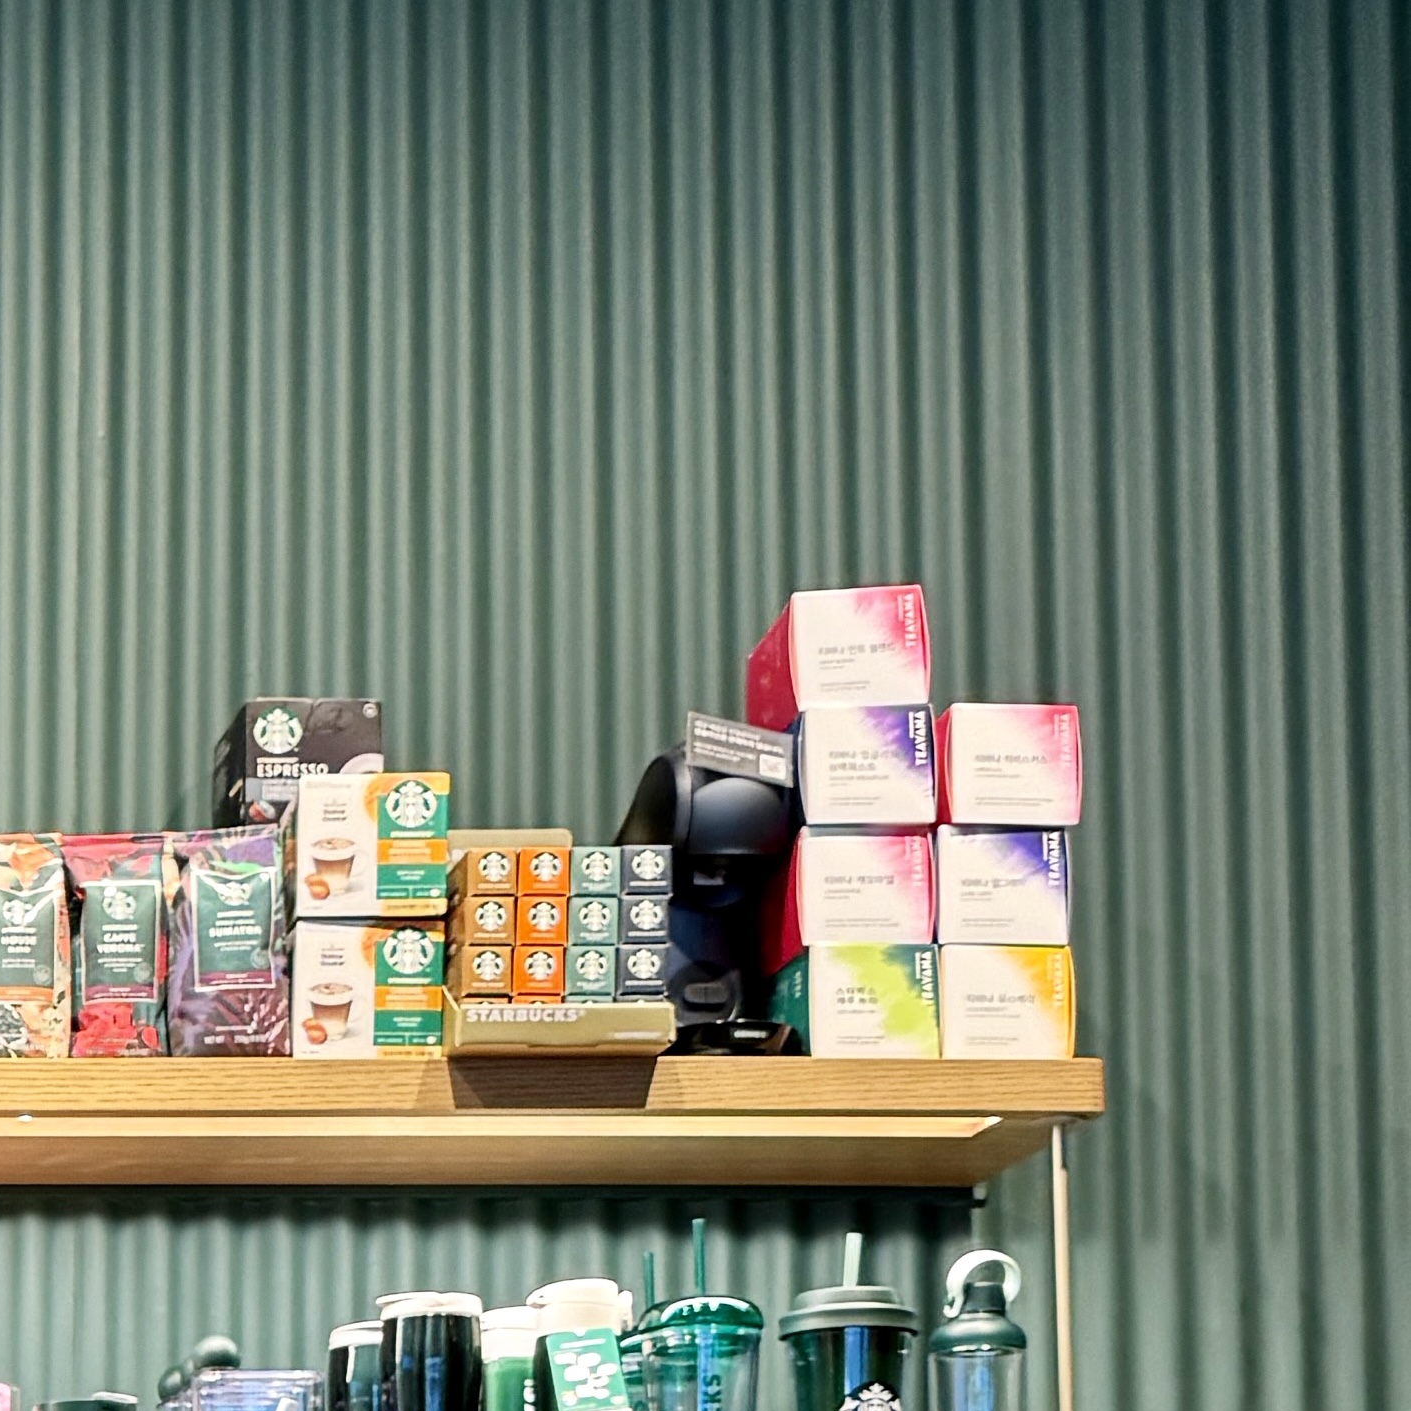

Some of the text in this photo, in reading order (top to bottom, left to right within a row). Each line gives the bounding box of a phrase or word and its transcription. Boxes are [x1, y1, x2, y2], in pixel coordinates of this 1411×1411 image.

[913, 711, 928, 766] TEAVANA
[257, 763, 329, 778] ESPRESSO
[466, 1009, 578, 1023] STARBUCKS
